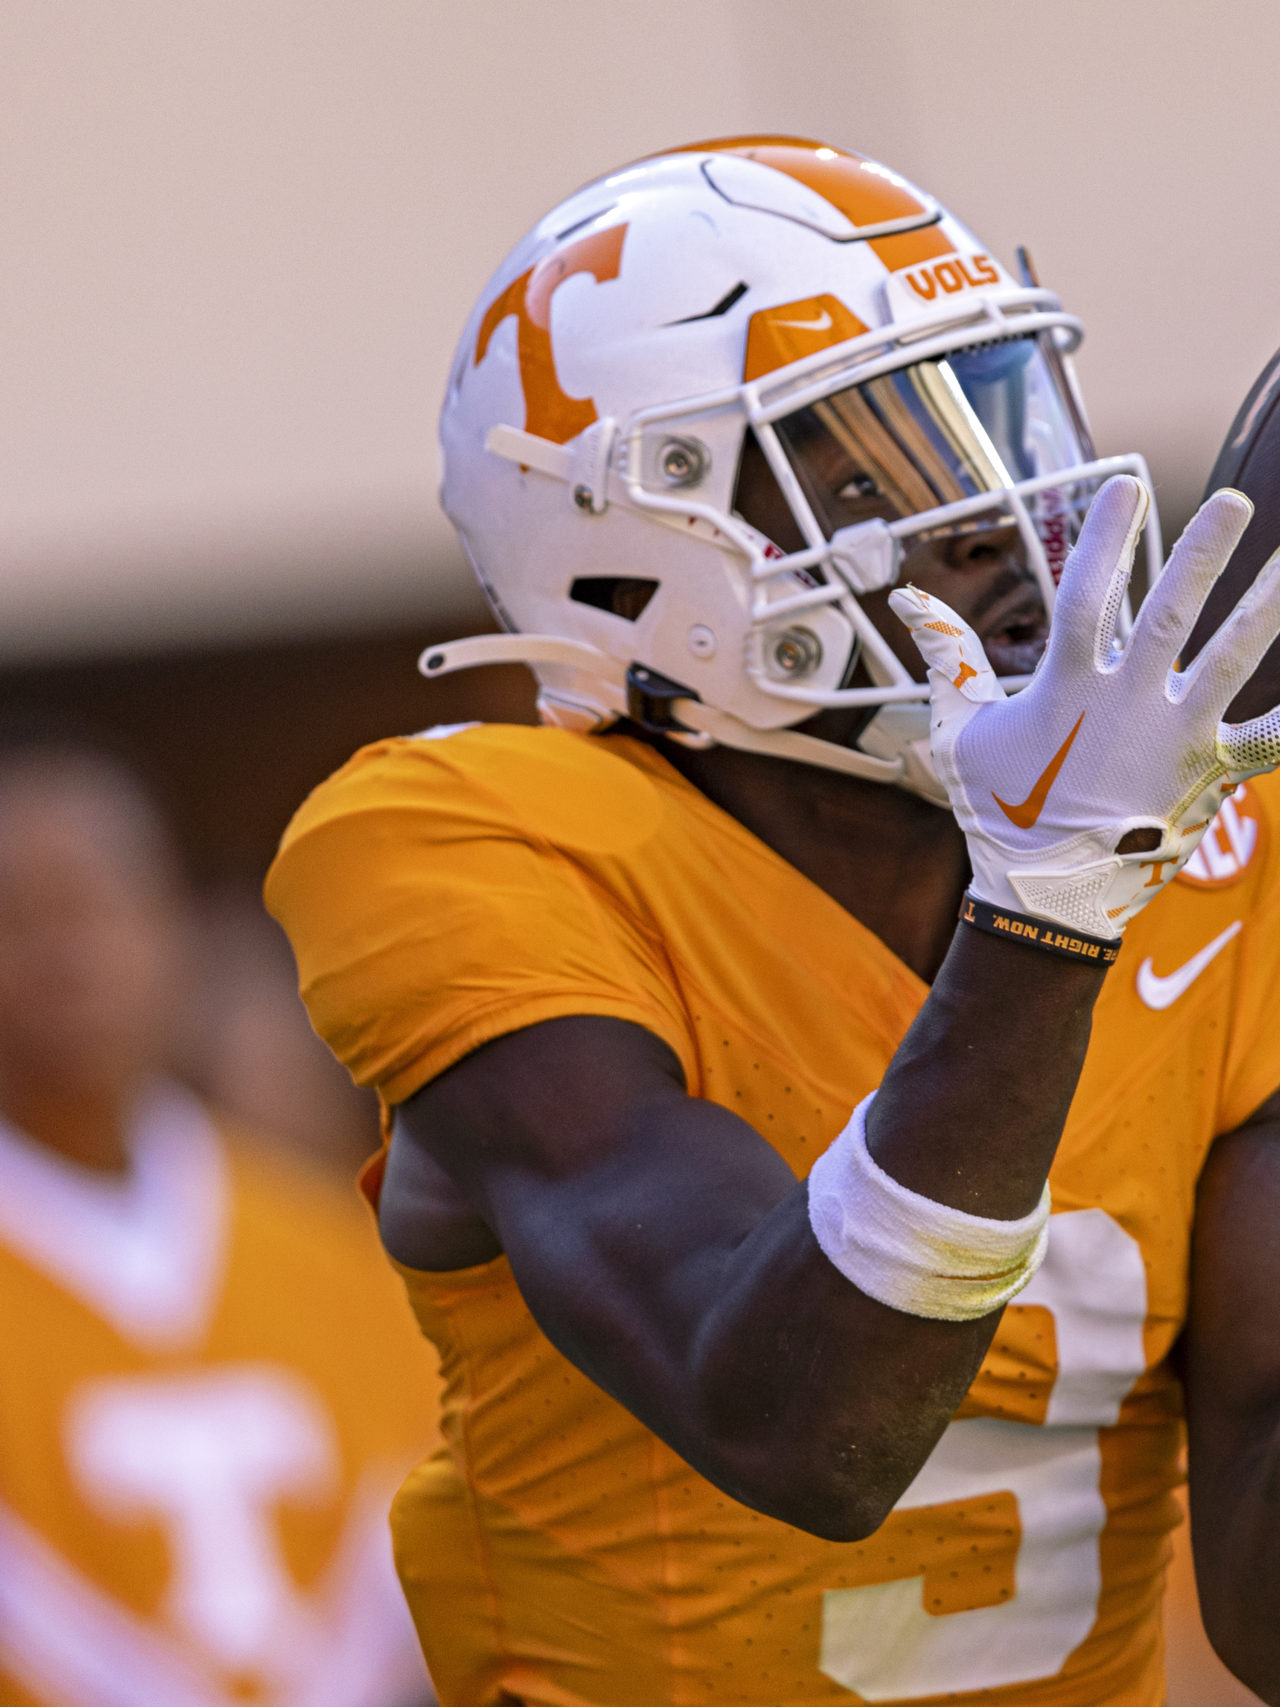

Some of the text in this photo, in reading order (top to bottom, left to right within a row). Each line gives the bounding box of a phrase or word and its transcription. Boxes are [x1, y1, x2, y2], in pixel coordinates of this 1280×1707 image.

[904, 254, 1000, 301] VOLS
[992, 914, 1039, 941] NOW.
[1040, 931, 1101, 959] RIGHT
